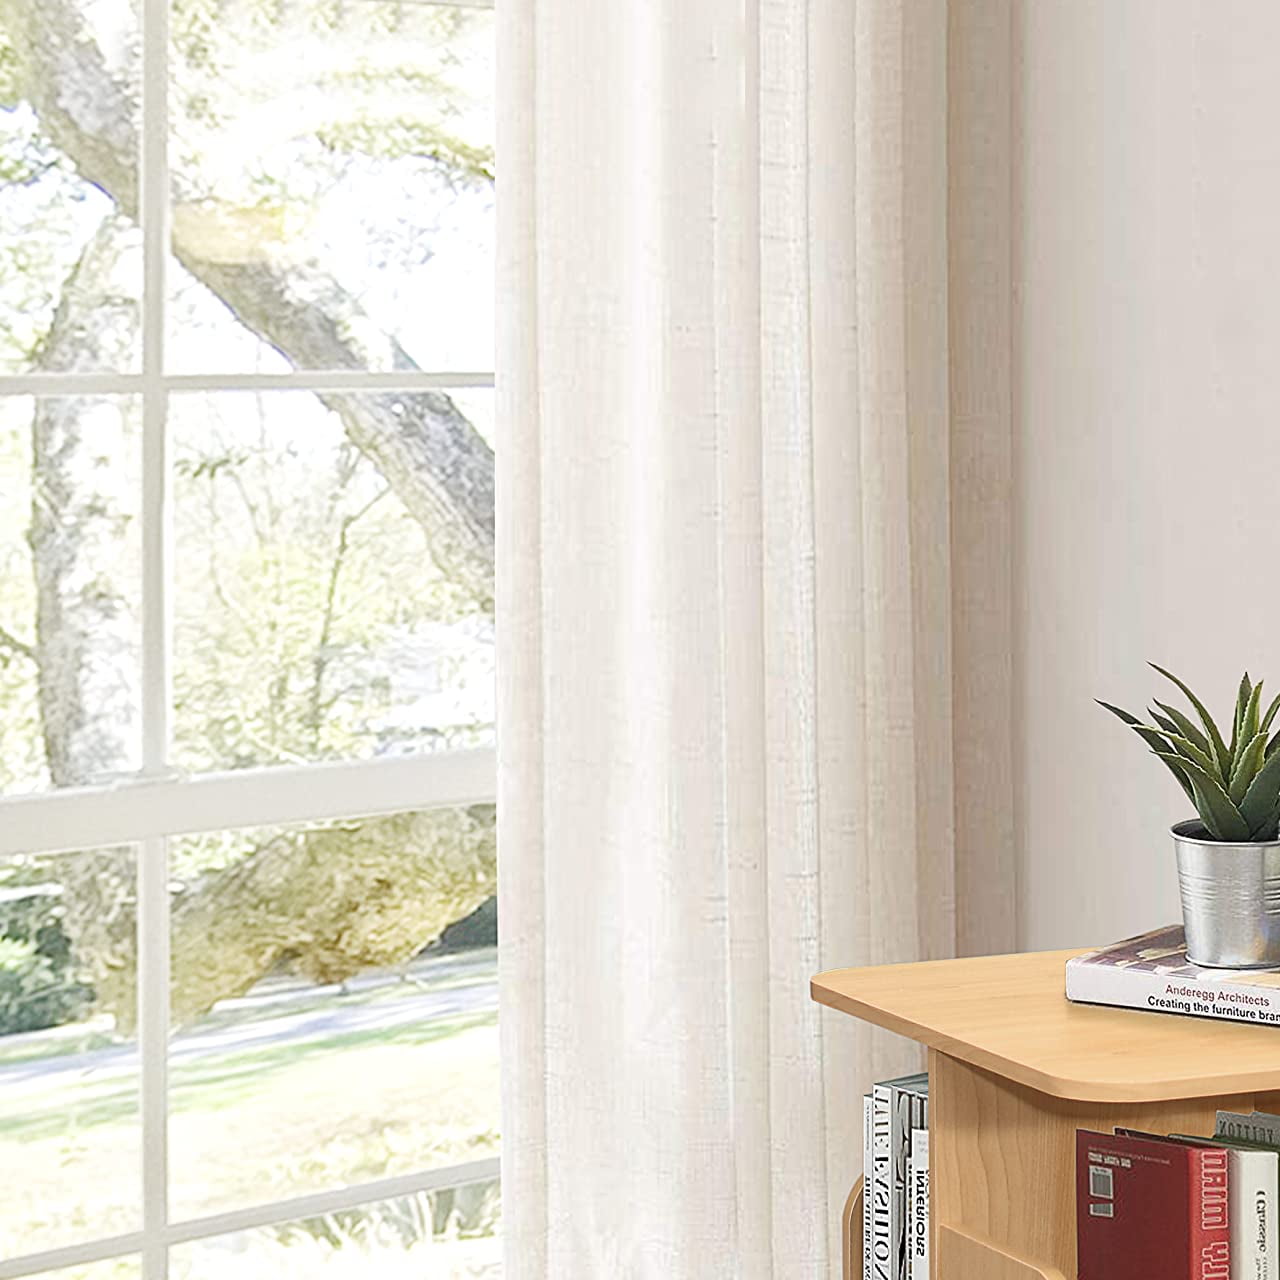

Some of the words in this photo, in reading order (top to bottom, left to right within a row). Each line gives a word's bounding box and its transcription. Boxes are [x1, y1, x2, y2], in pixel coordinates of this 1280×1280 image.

[1148, 995, 1191, 1013] Creating
[1193, 1001, 1210, 1013] the
[1212, 1003, 1256, 1019] furniture
[1166, 984, 1215, 1002] Anderegg
[1217, 990, 1270, 1007] Architects
